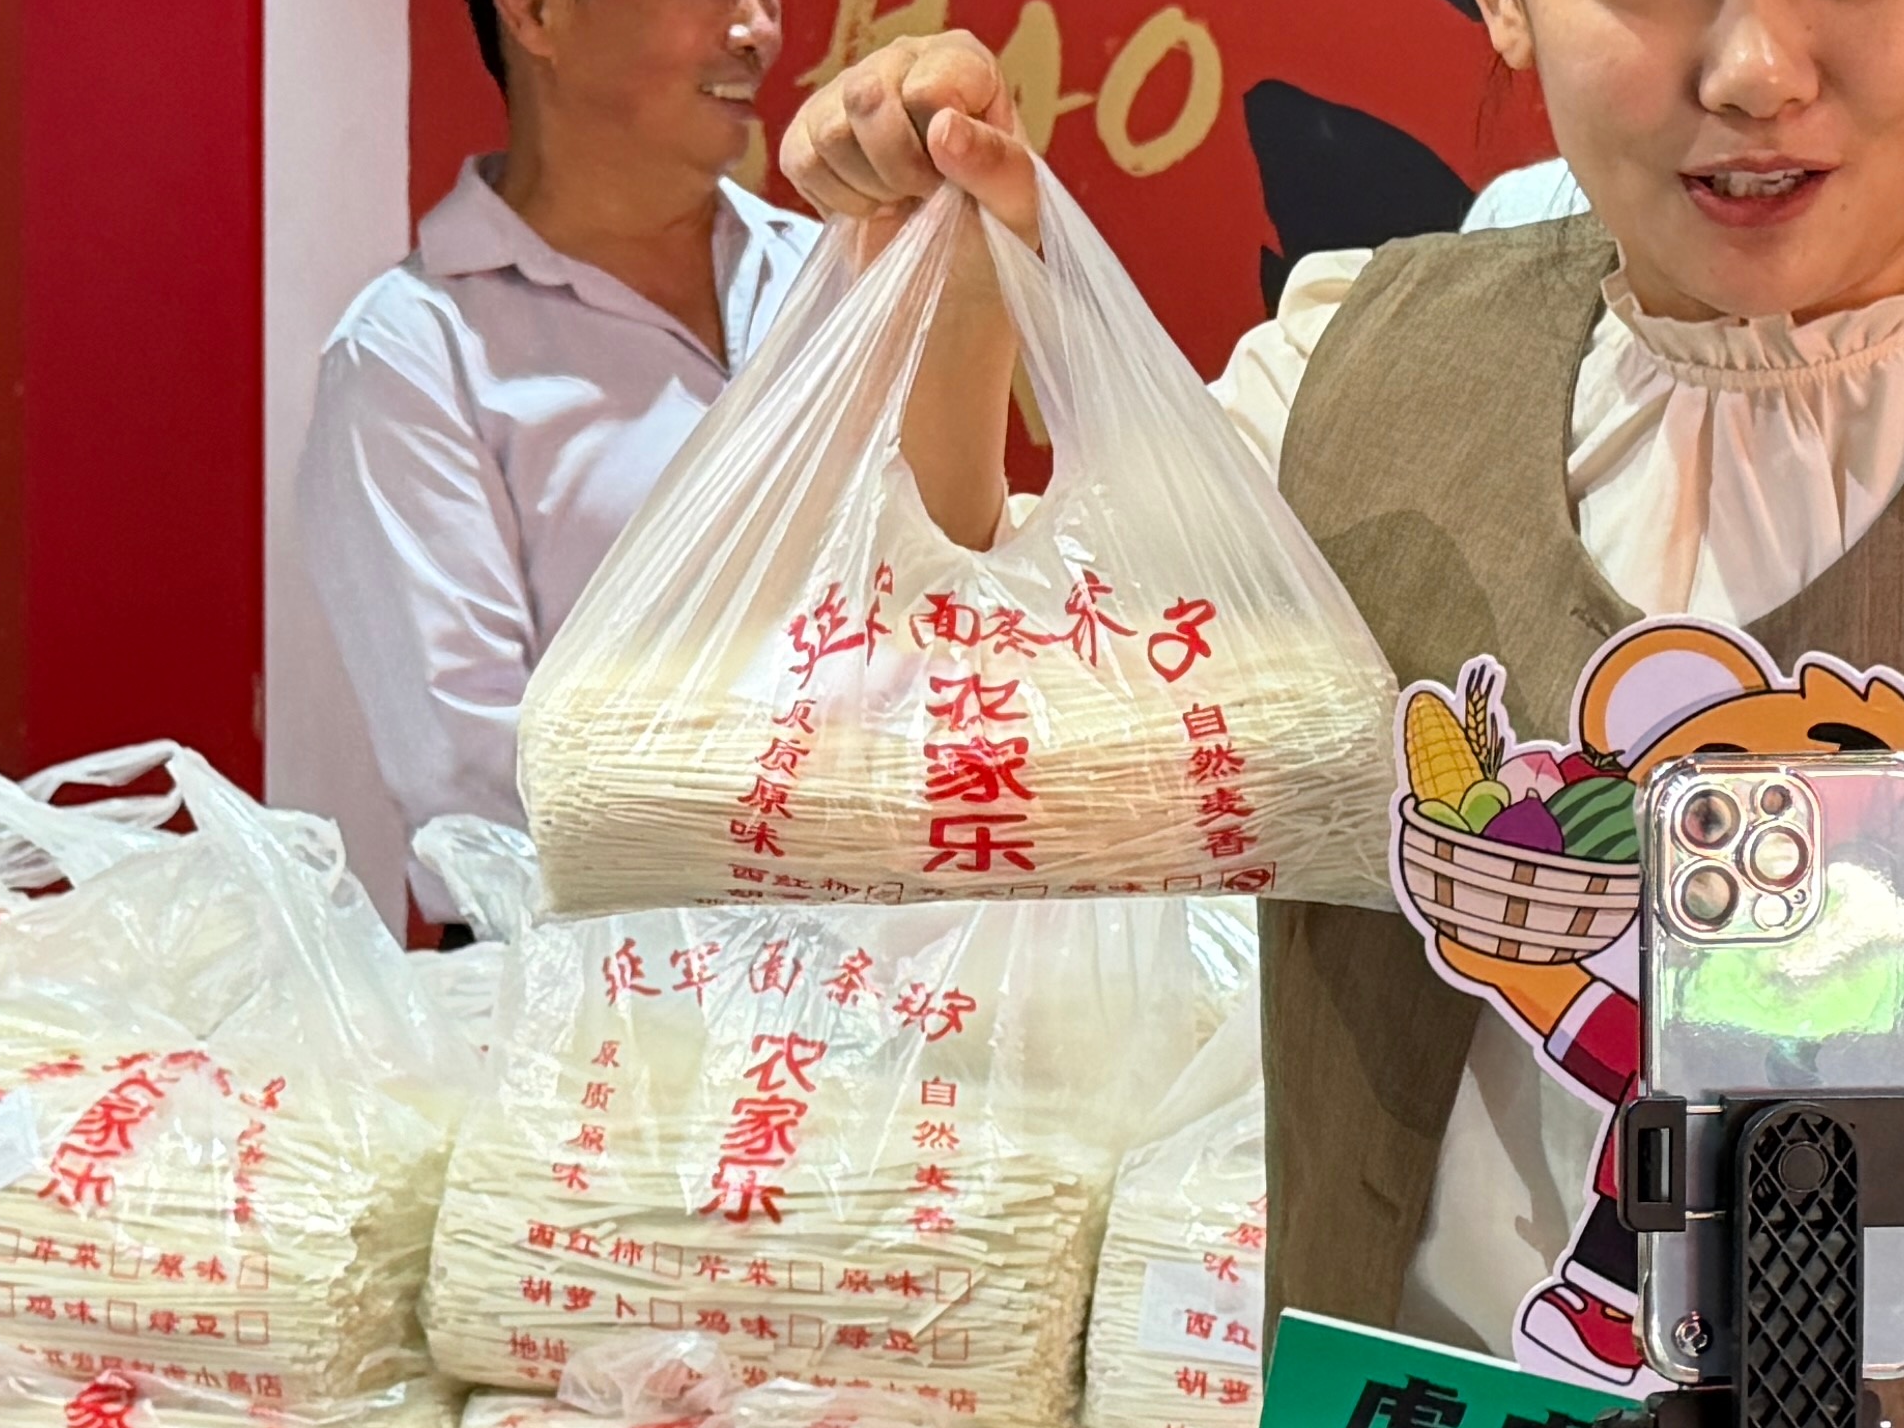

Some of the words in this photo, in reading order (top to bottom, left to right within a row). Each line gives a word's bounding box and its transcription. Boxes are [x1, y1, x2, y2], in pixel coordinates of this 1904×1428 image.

[922, 672, 1038, 874] 农家乐
[1180, 702, 1257, 857] 自然麦香
[550, 1037, 623, 1193] 原质原味
[698, 1031, 827, 1225] 农家乐
[32, 1236, 101, 1270] 芹菜
[152, 1252, 228, 1282] 原味
[519, 1275, 639, 1321] 胡萝卜
[526, 1219, 645, 1267] 西红柿
[695, 1250, 778, 1290] 芹菜
[834, 1265, 924, 1300] 原味
